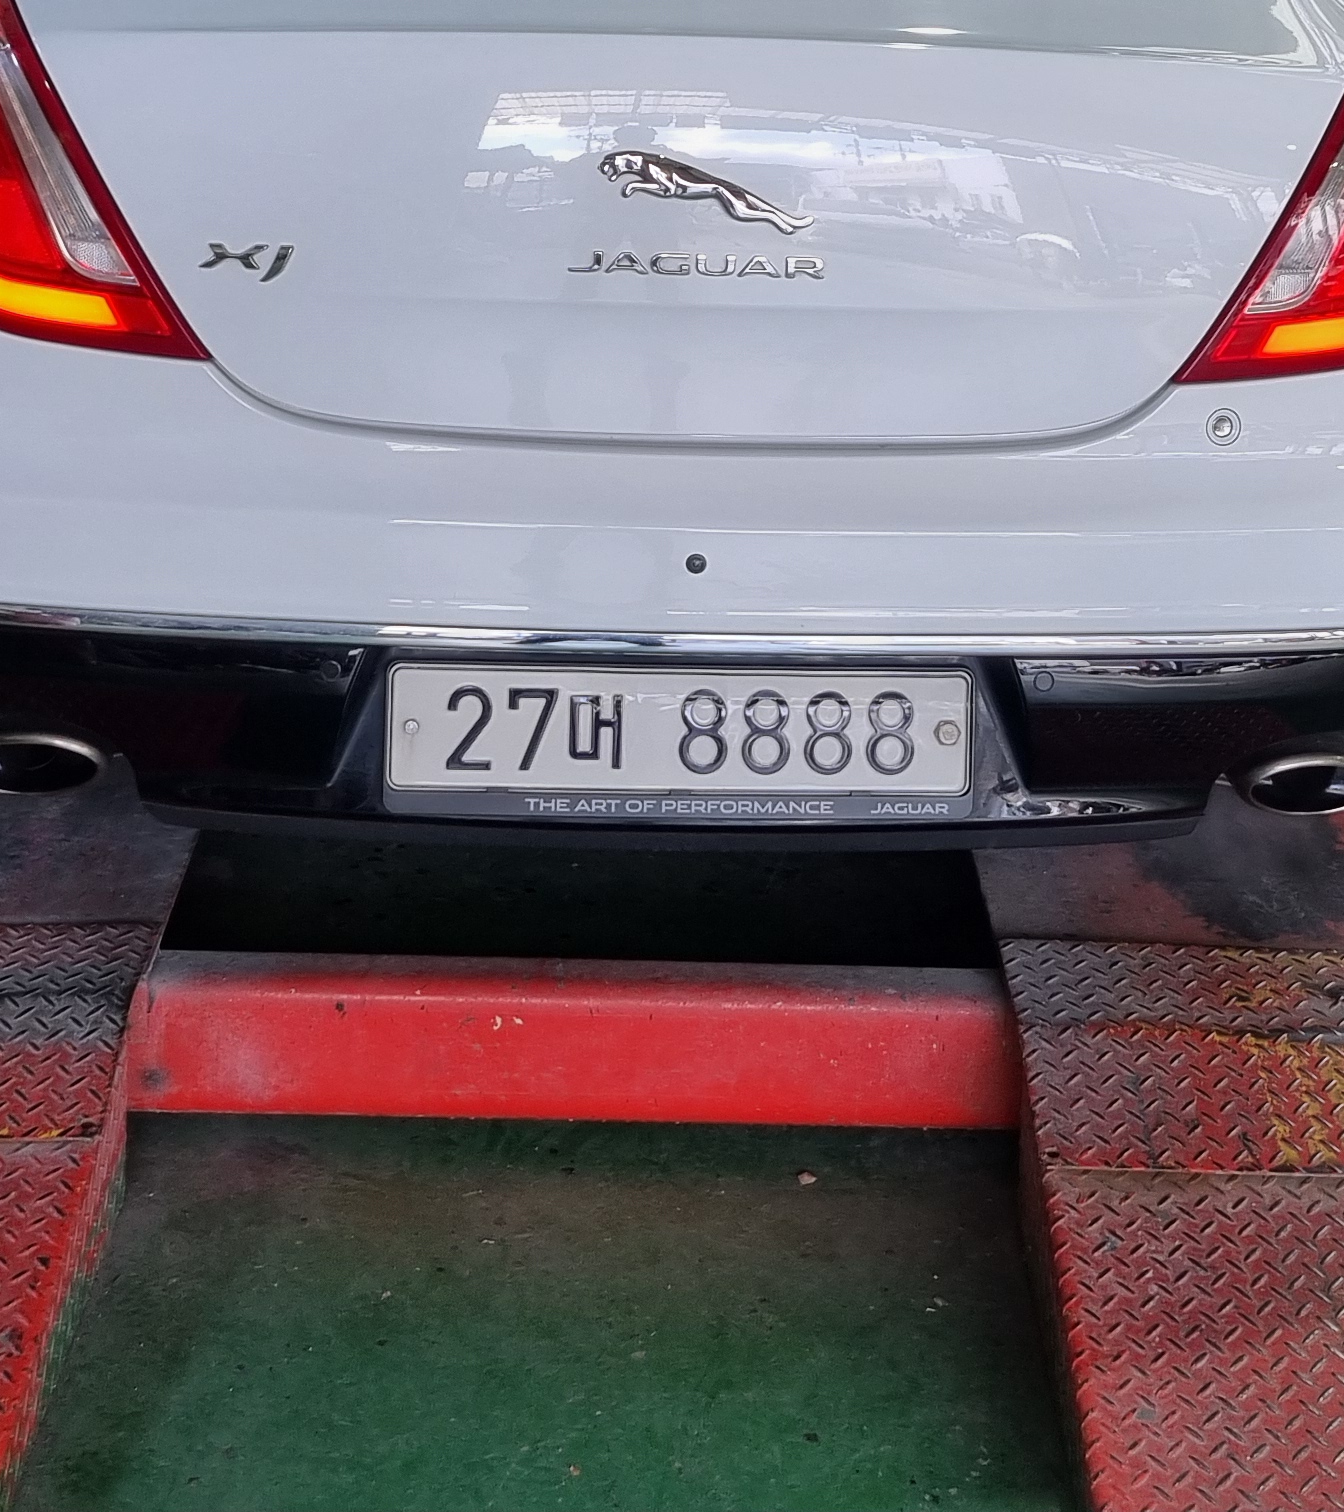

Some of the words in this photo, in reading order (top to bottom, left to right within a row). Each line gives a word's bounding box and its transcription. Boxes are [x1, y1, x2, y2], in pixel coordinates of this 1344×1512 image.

[197, 242, 295, 283] XJ
[567, 250, 826, 281] JAGUAR
[445, 685, 624, 771] 27머
[678, 688, 915, 776] 8888
[524, 798, 571, 812] THE
[574, 799, 621, 813] ART
[624, 799, 658, 813] OF
[661, 800, 835, 815] PERFORMANCE
[870, 802, 949, 815] JAGUAR
